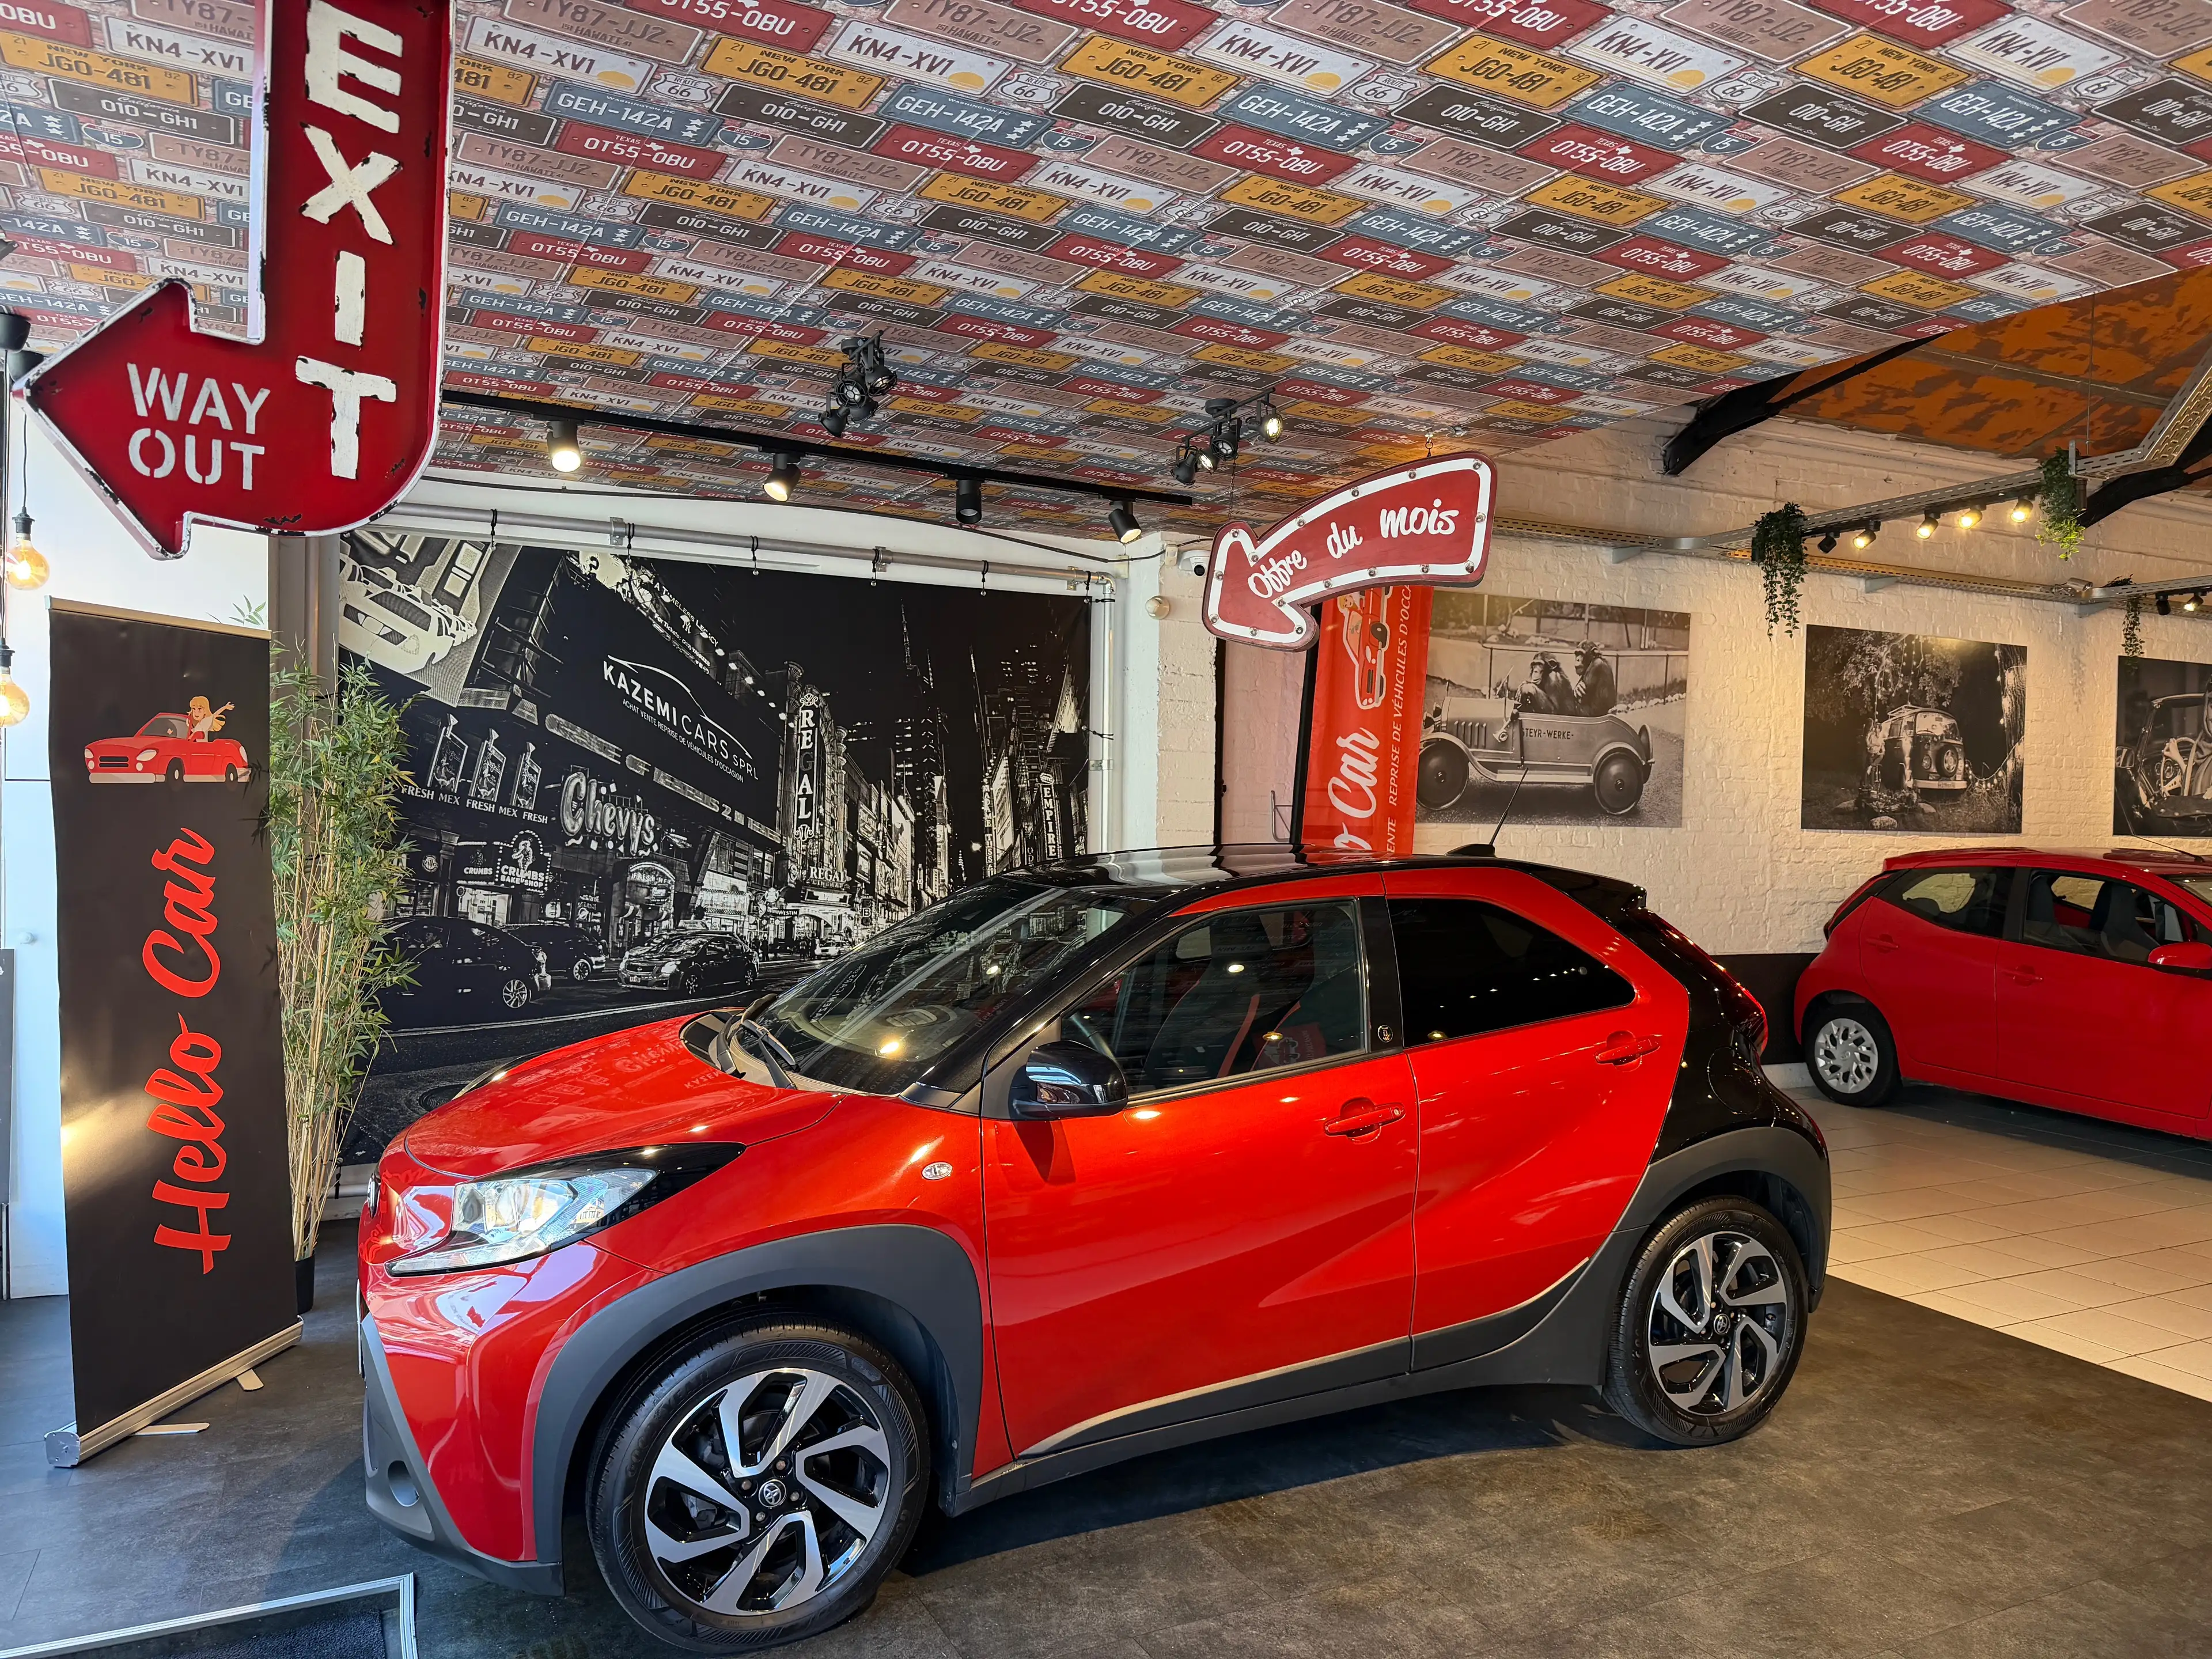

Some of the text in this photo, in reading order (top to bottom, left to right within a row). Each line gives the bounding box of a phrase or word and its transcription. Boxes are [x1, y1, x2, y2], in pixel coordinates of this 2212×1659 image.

[946, 26, 993, 44] HAWAII
[1097, 41, 1115, 51] 21
[1854, 40, 1876, 50] 21
[47, 45, 149, 71] NEW YORK
[124, 31, 246, 73] KN4-XV1
[482, 32, 597, 75] KN4-XV1
[759, 50, 846, 76] NEW YORK
[846, 34, 956, 77] KN4-XV1
[1124, 49, 1205, 74] NEW YORK
[1215, 33, 1321, 77] KN4-XV1
[1497, 48, 1571, 74] NEW YORK
[1591, 30, 1693, 74] KN4-XV1
[1876, 47, 1943, 73] NEW YORK
[1974, 29, 2071, 73] KN4-XV1
[668, 85, 691, 97] 66
[1014, 85, 1037, 97] 66
[1365, 86, 1389, 99] 66
[1723, 84, 1748, 97] 66
[557, 93, 674, 130] GEH-142A
[783, 100, 838, 116] California
[895, 95, 1006, 132] GEH-142A
[1124, 99, 1176, 115] California
[1237, 96, 1343, 133] GEH-142A
[1472, 100, 1520, 116] California
[1586, 94, 1688, 132] GEH-142A
[1824, 100, 1868, 116] California
[1941, 93, 2037, 131] GEH-142A
[616, 134, 642, 144] TEXAS
[733, 133, 753, 146] 15
[937, 137, 963, 147] TEXAS
[1054, 135, 1076, 147] 15
[1262, 139, 1287, 148] TEXAS
[1380, 138, 1404, 150] 15
[1593, 138, 1619, 147] TEXAS
[1711, 137, 1738, 150] 15
[145, 168, 245, 198] KN4-XV1
[739, 169, 832, 199] KN4-XV1
[1043, 170, 1133, 200] KN4-XV1
[1351, 172, 1438, 203] KN4-XV1
[1664, 172, 1747, 202] KN4-XV1
[1982, 169, 2062, 200] KN4-XV1
[295, 0, 403, 480] EXIT
[126, 361, 271, 435] WAY
[127, 427, 266, 491] OUT
[1247, 498, 1460, 599] Offre du mois
[1393, 639, 1408, 717] VÉHICULES
[603, 660, 759, 781] KAZEMI CARS SPRL
[1392, 720, 1402, 743] DE
[1522, 728, 1574, 740] TEYR-WERKE-
[623, 698, 744, 783] ACHAT VENTE REPRISE DE VÉHICULES D'OCCASION
[797, 709, 816, 820] REGAL
[1328, 726, 1380, 819] Car
[1389, 747, 1402, 806] REPRISE
[401, 784, 549, 824] FRESH MEX FRESH MEX FRESH
[560, 771, 656, 857] Chevys
[1043, 787, 1057, 857] EMPIRE
[1387, 816, 1396, 853] ENTE
[463, 866, 494, 876] CRUMBS
[500, 865, 546, 882] CRUMBS
[809, 865, 847, 883] REGAL
[142, 827, 232, 1275] Hello Car
